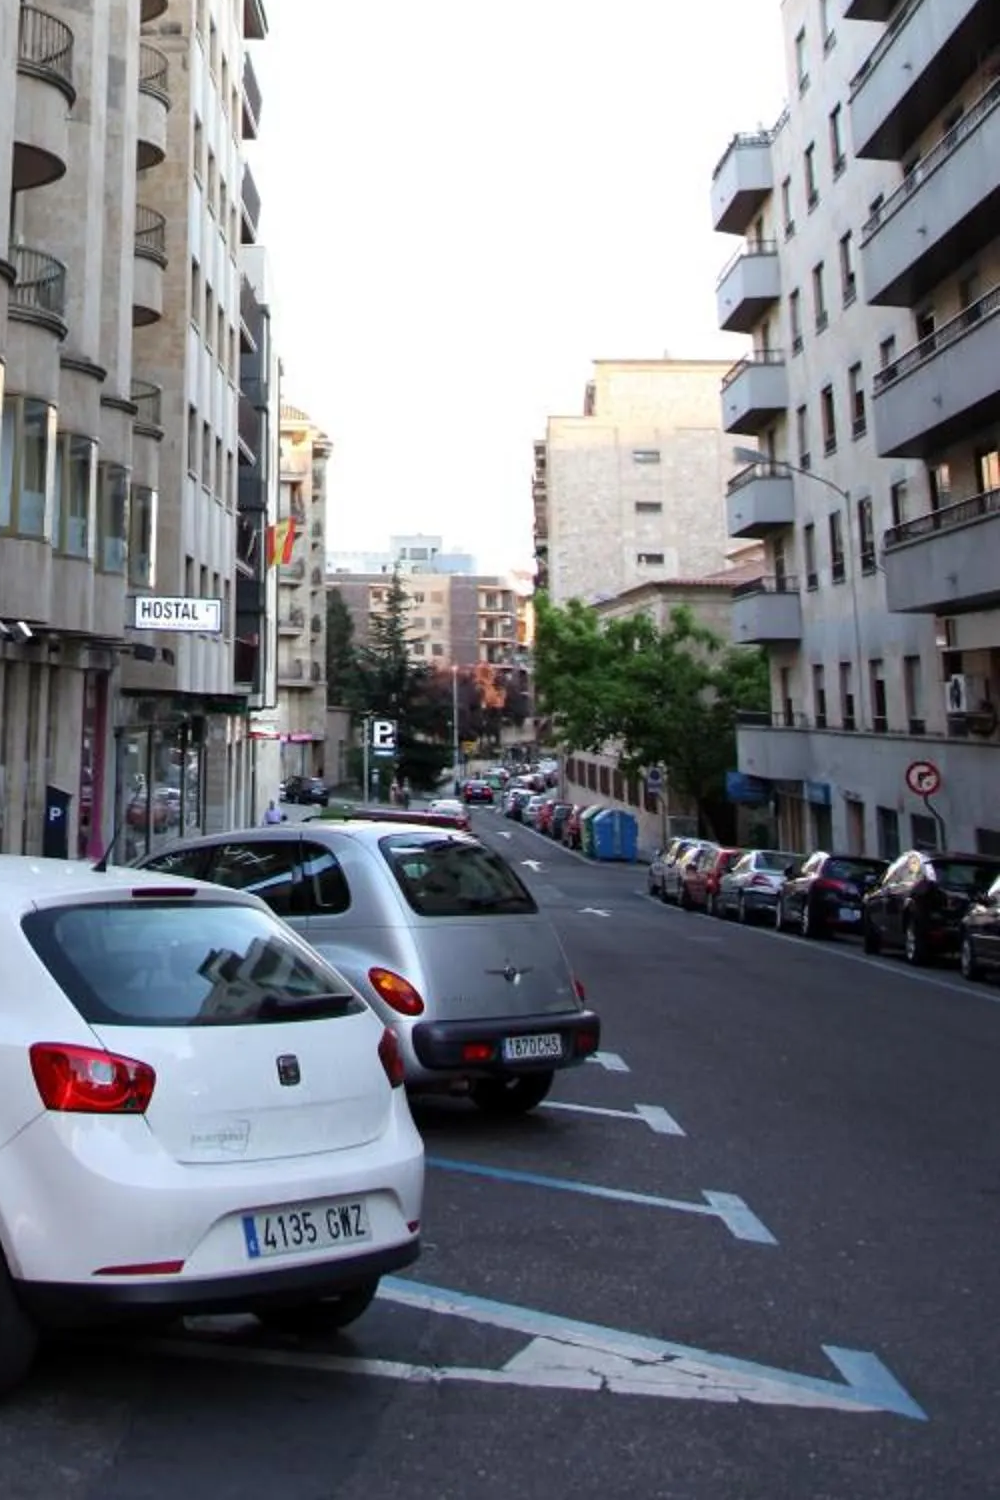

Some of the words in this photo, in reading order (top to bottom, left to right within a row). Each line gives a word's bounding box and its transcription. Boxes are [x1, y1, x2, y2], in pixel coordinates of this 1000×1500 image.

[141, 601, 199, 620] HOSTAL
[49, 806, 61, 821] P
[263, 1211, 317, 1249] 4135
[325, 1204, 366, 1239] GWZ
